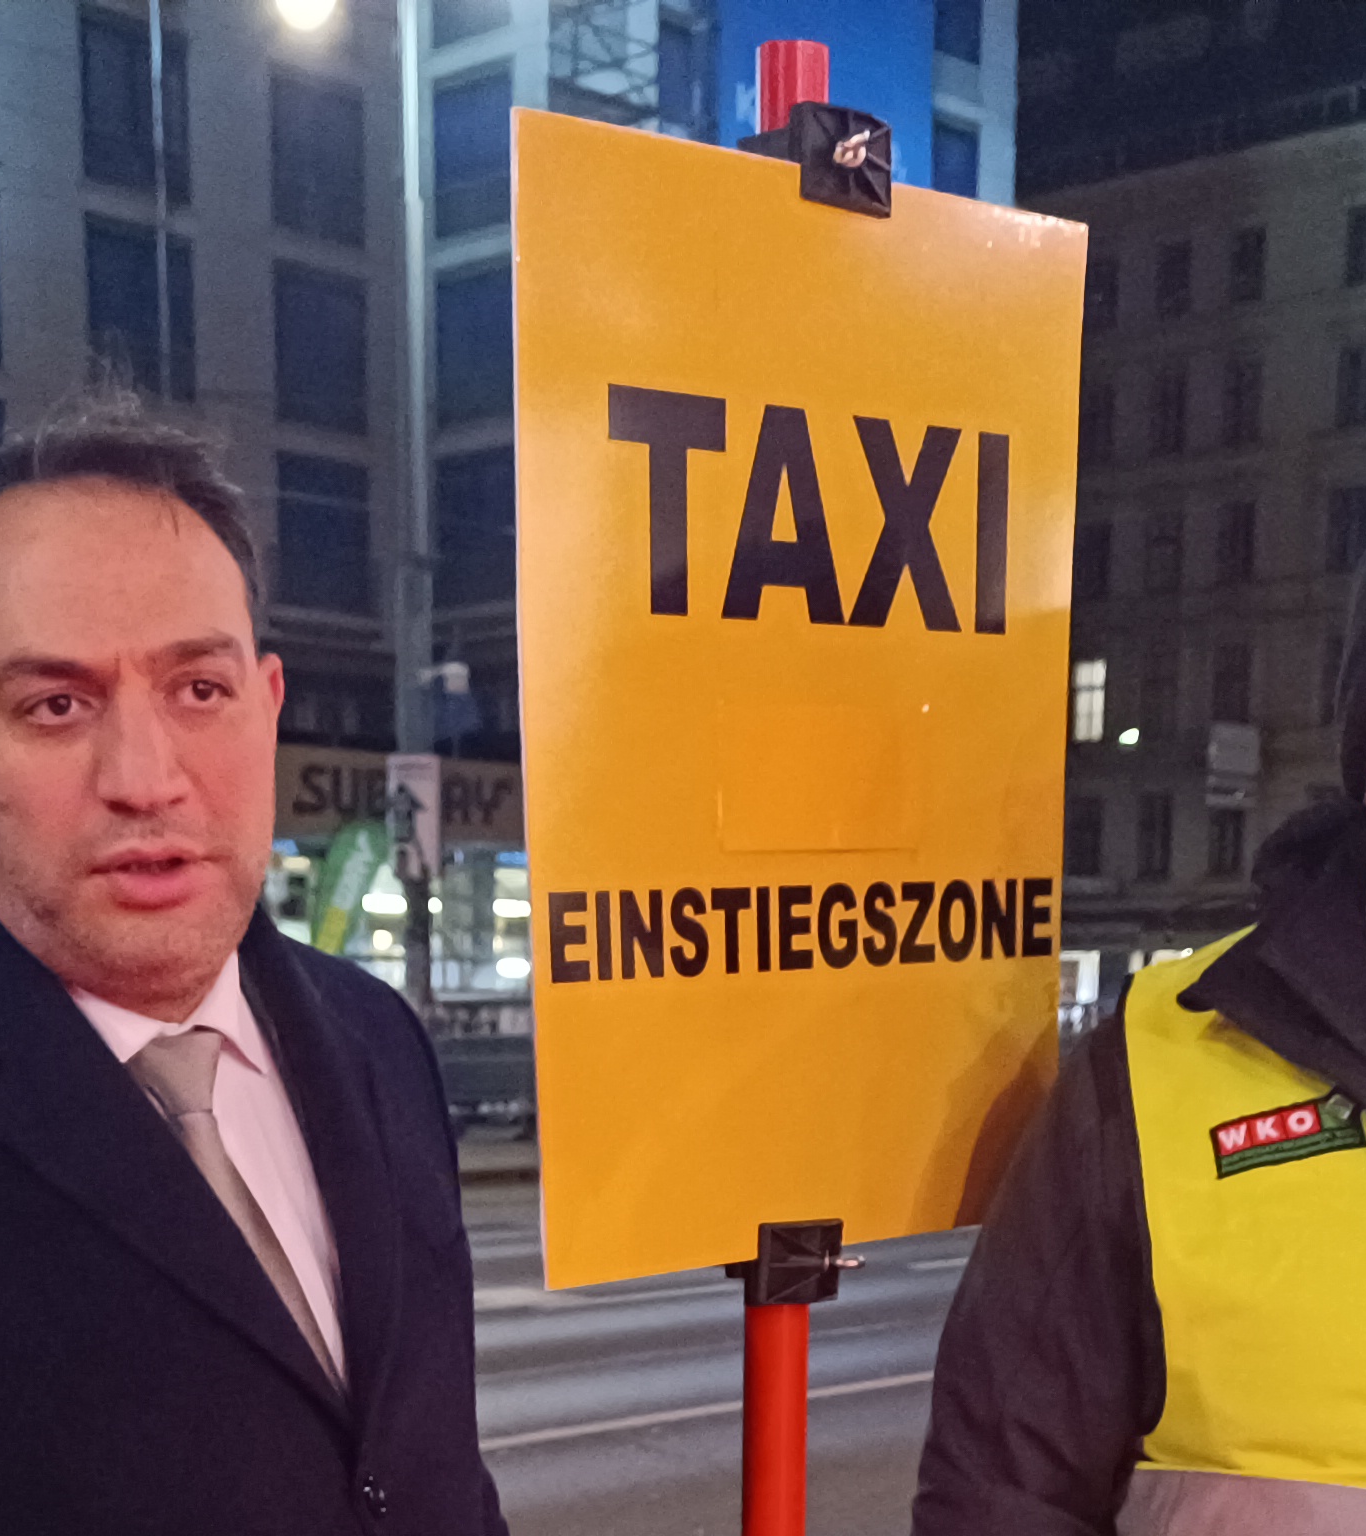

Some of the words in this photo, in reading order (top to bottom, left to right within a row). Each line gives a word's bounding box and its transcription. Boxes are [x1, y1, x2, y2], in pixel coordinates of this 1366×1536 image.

[608, 383, 1010, 635] TAXI
[293, 764, 514, 825] SUBAY
[548, 878, 1054, 984] EINSTIEGSZONE
[1218, 1111, 1314, 1150] WKO
